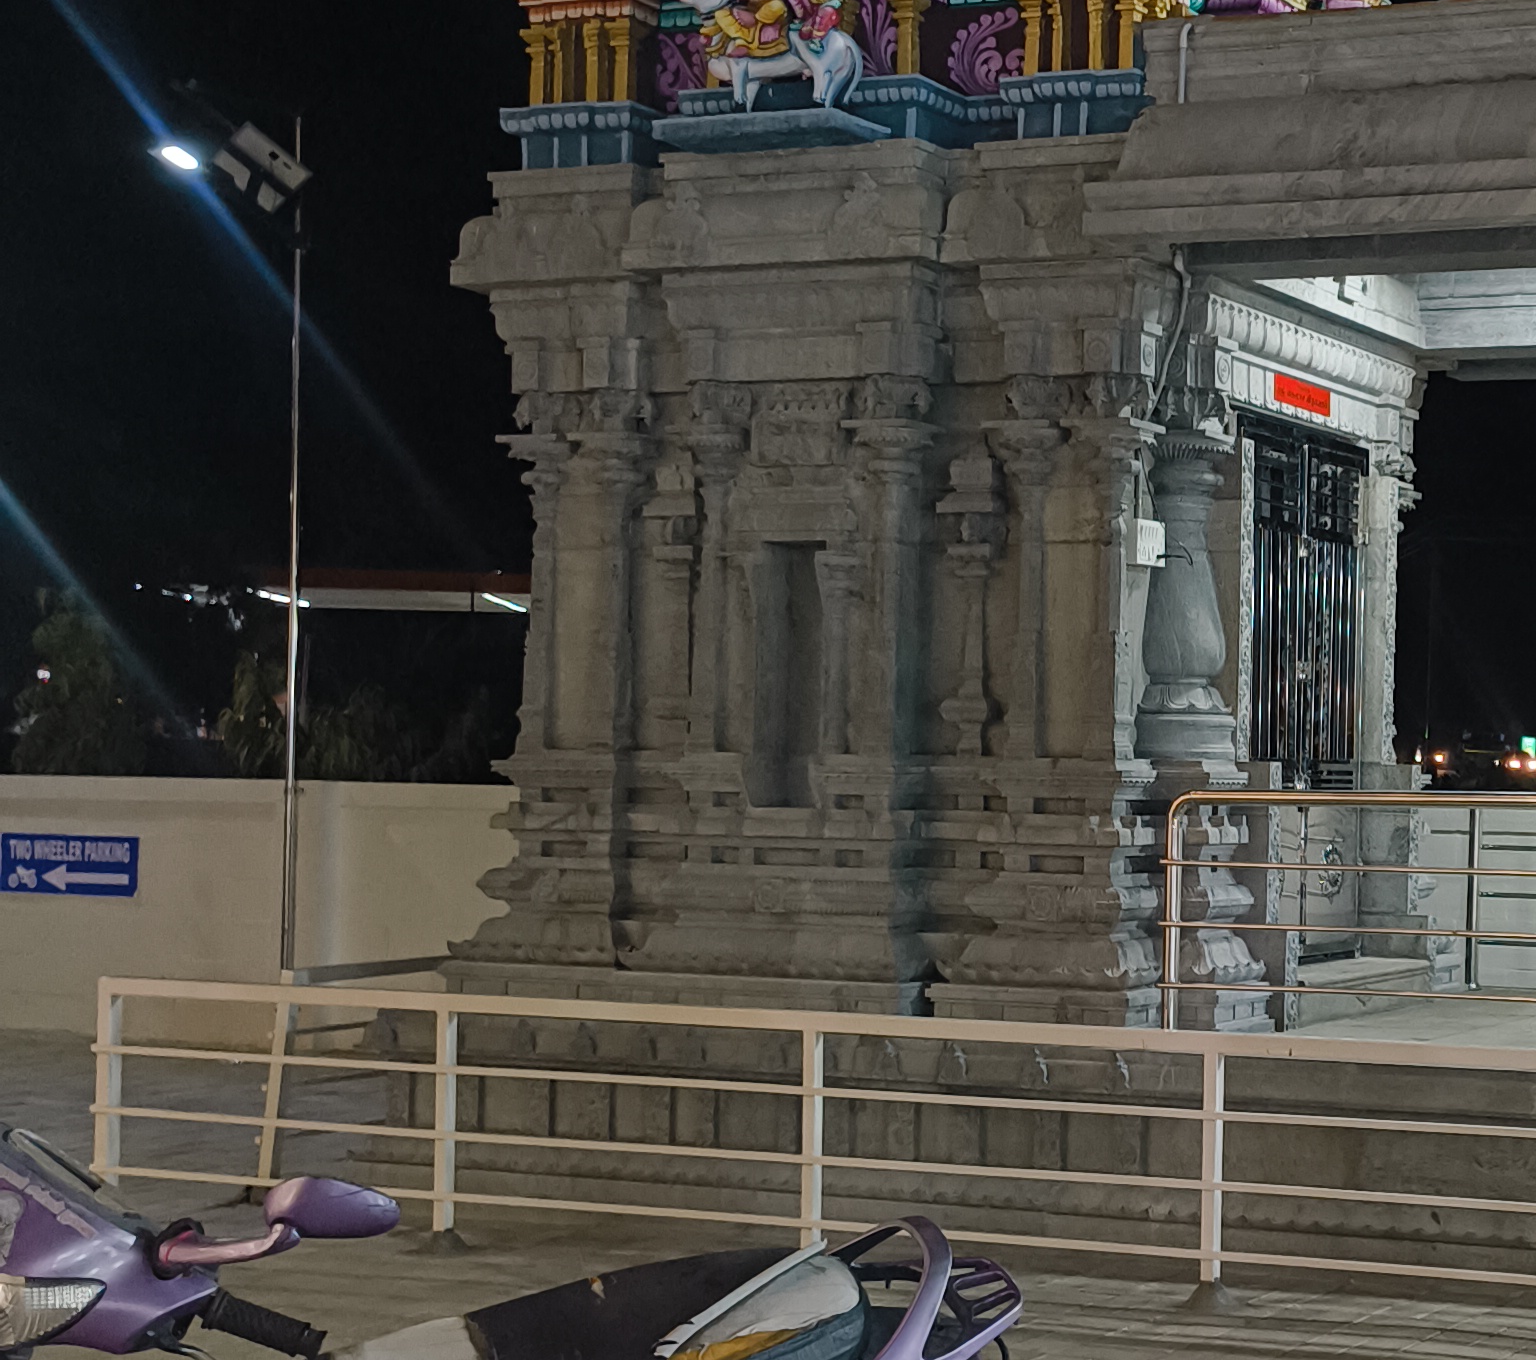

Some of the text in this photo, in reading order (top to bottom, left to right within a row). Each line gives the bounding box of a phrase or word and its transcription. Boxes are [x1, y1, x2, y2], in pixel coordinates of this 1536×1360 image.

[9, 839, 130, 863] TWO WHEELER PARKING
